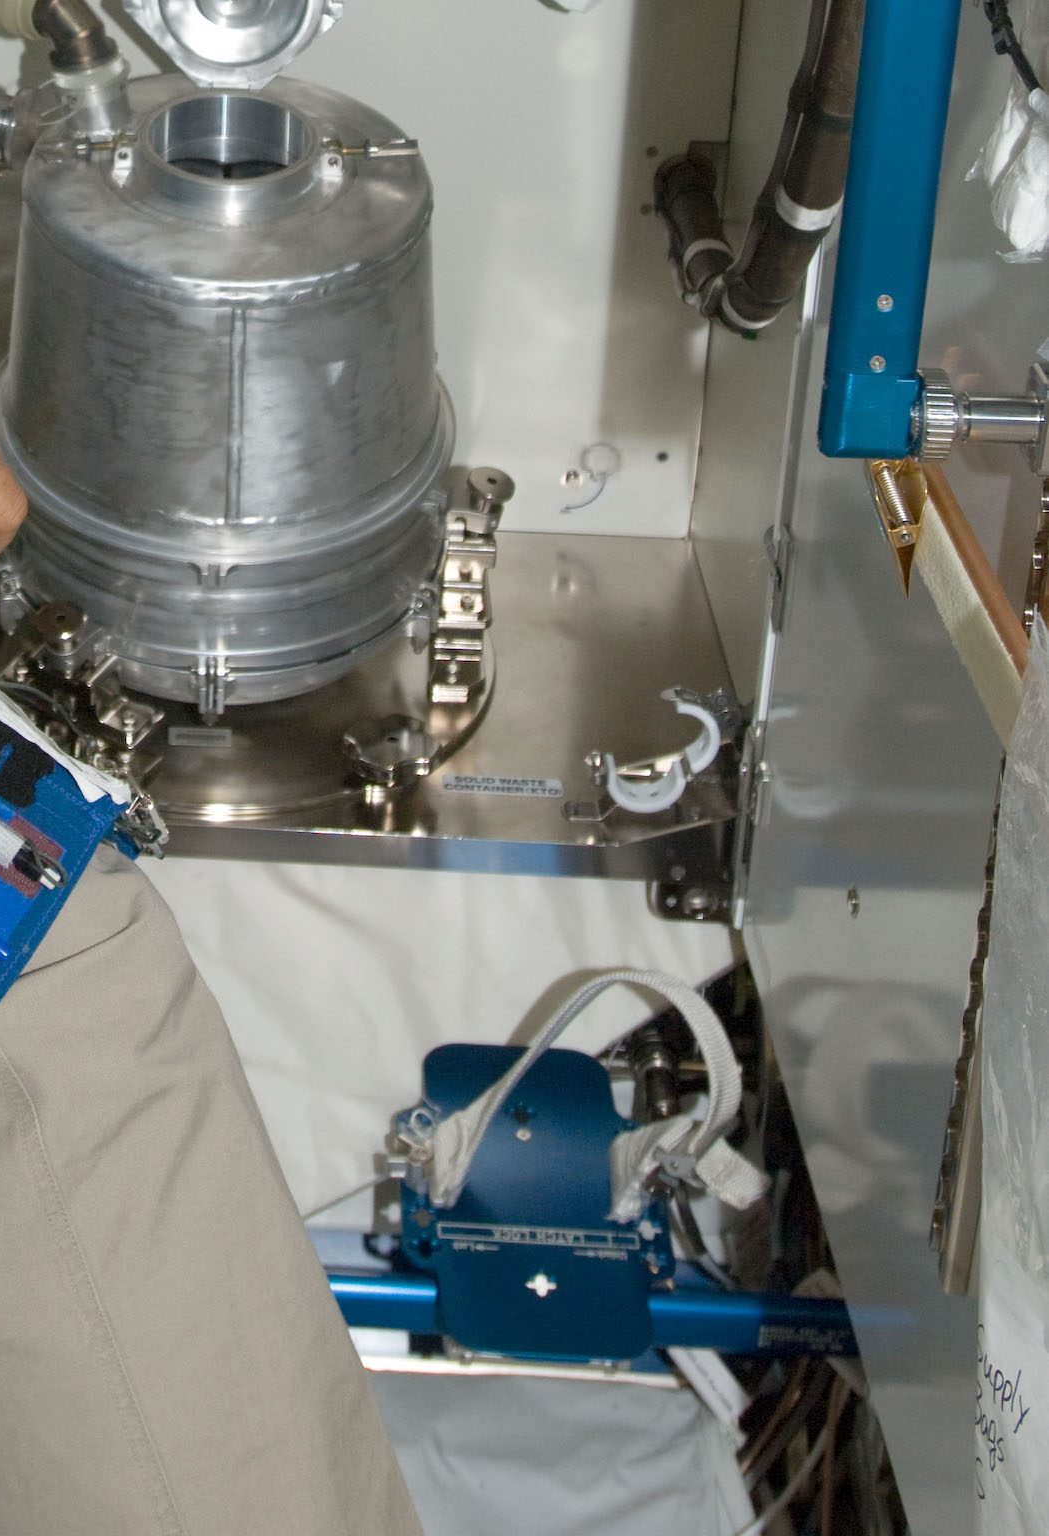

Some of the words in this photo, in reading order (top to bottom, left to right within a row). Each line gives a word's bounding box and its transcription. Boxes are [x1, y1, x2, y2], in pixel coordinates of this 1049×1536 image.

[454, 775, 496, 784] SOLID
[497, 778, 546, 787] WASTE
[977, 1324, 1031, 1434] Supply
